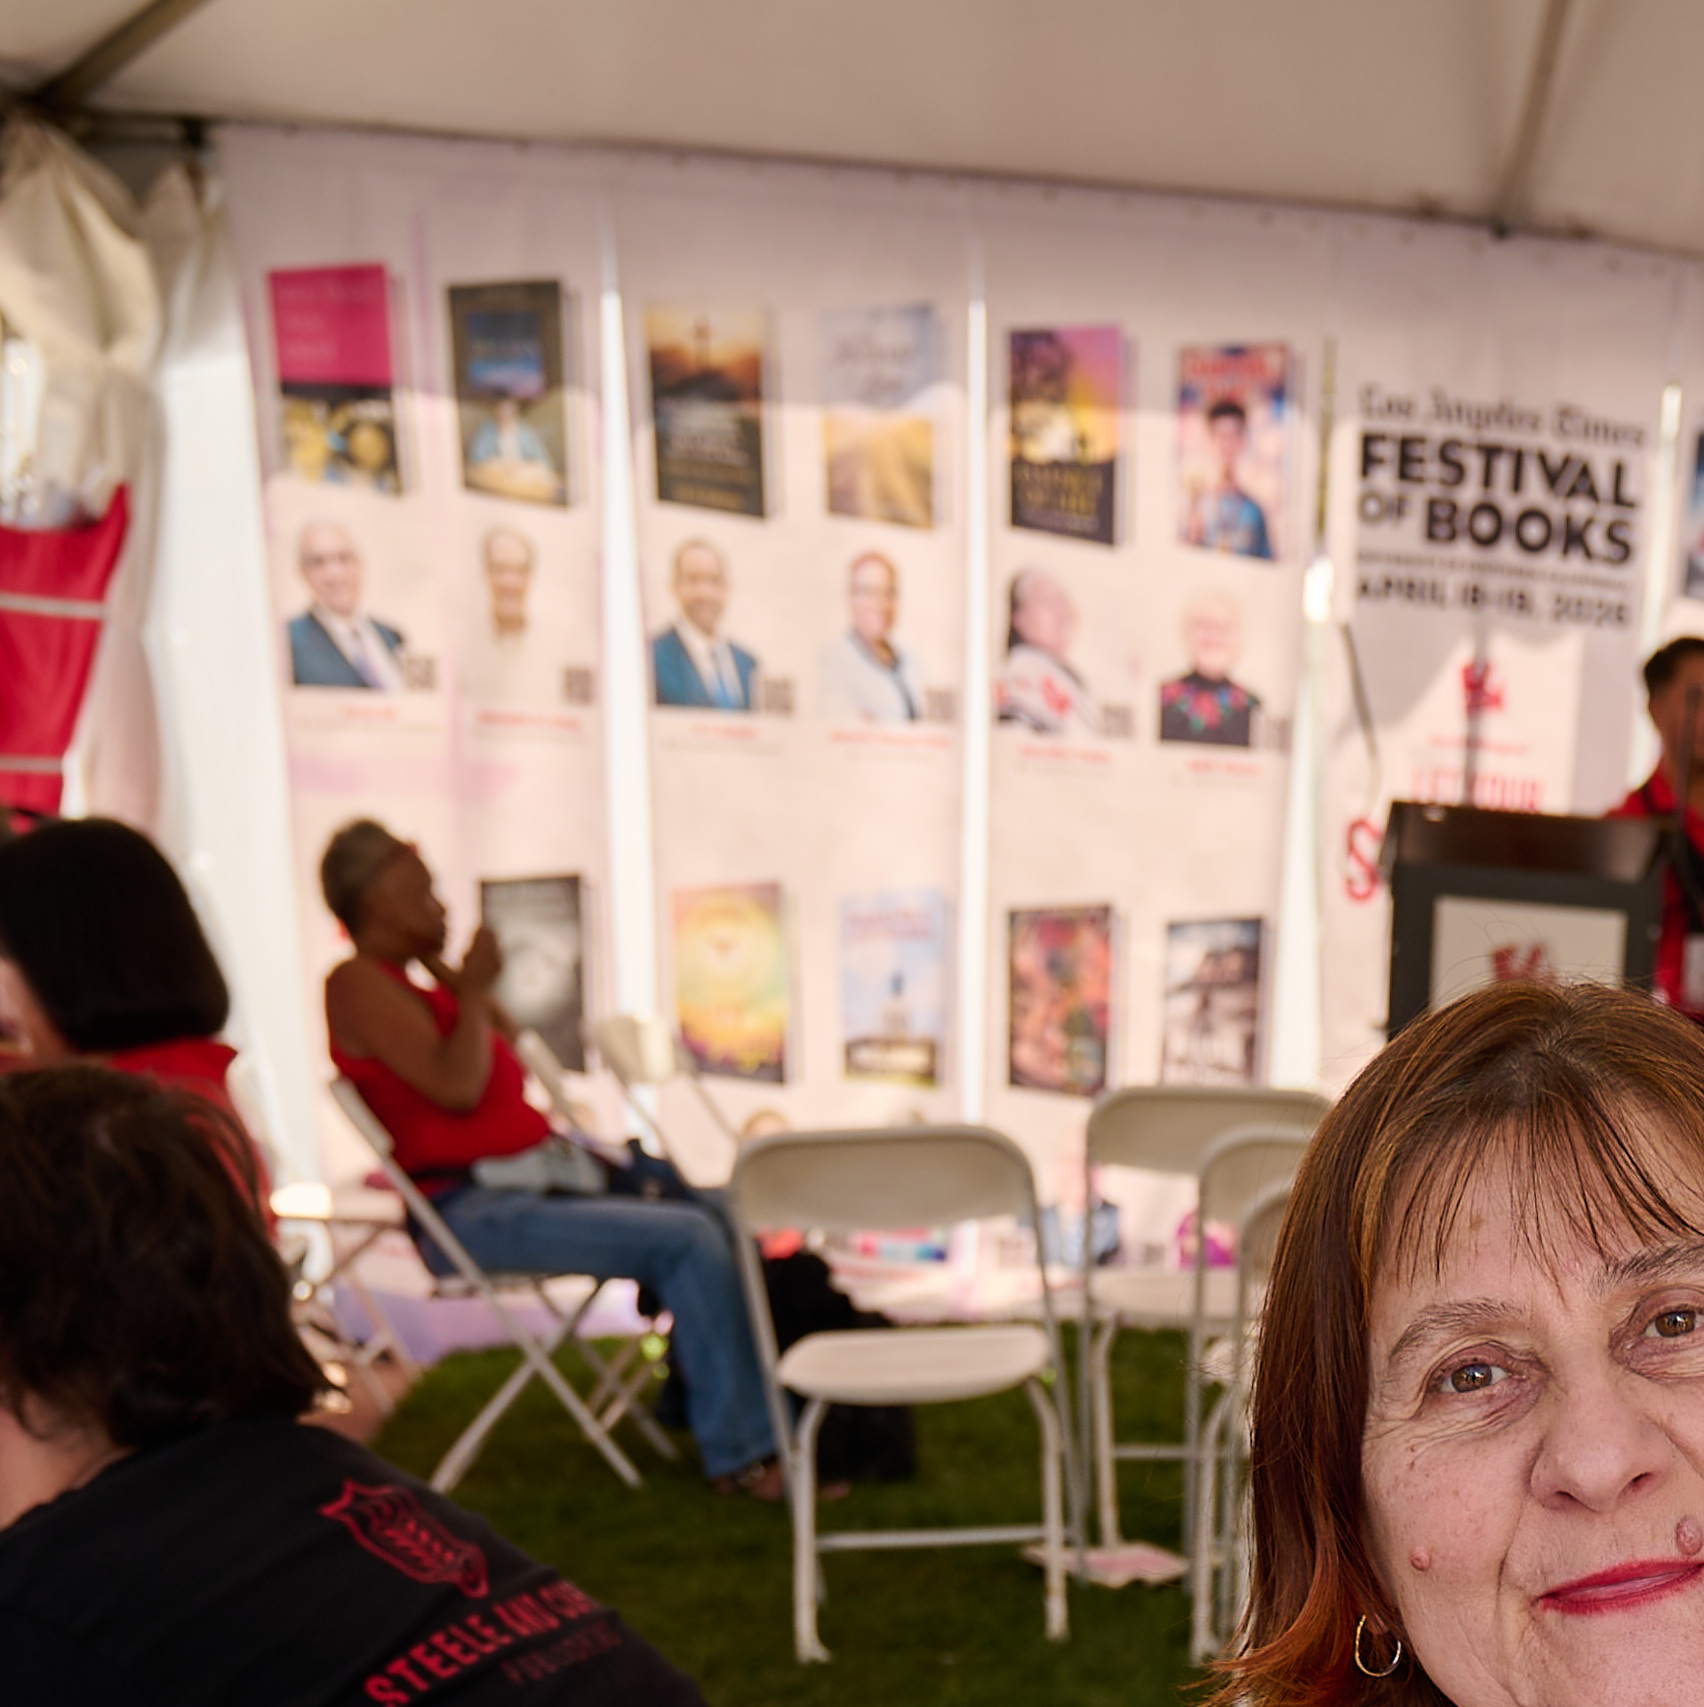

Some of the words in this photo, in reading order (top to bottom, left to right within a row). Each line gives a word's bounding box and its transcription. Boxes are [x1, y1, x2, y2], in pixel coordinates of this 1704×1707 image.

[1430, 385, 1541, 431] Angeles
[1556, 403, 1644, 446] Times
[1361, 433, 1636, 508] FESTIVAL
[1359, 491, 1410, 523] OF
[1425, 497, 1633, 565] BOOKS
[1358, 577, 1446, 607] APRIL
